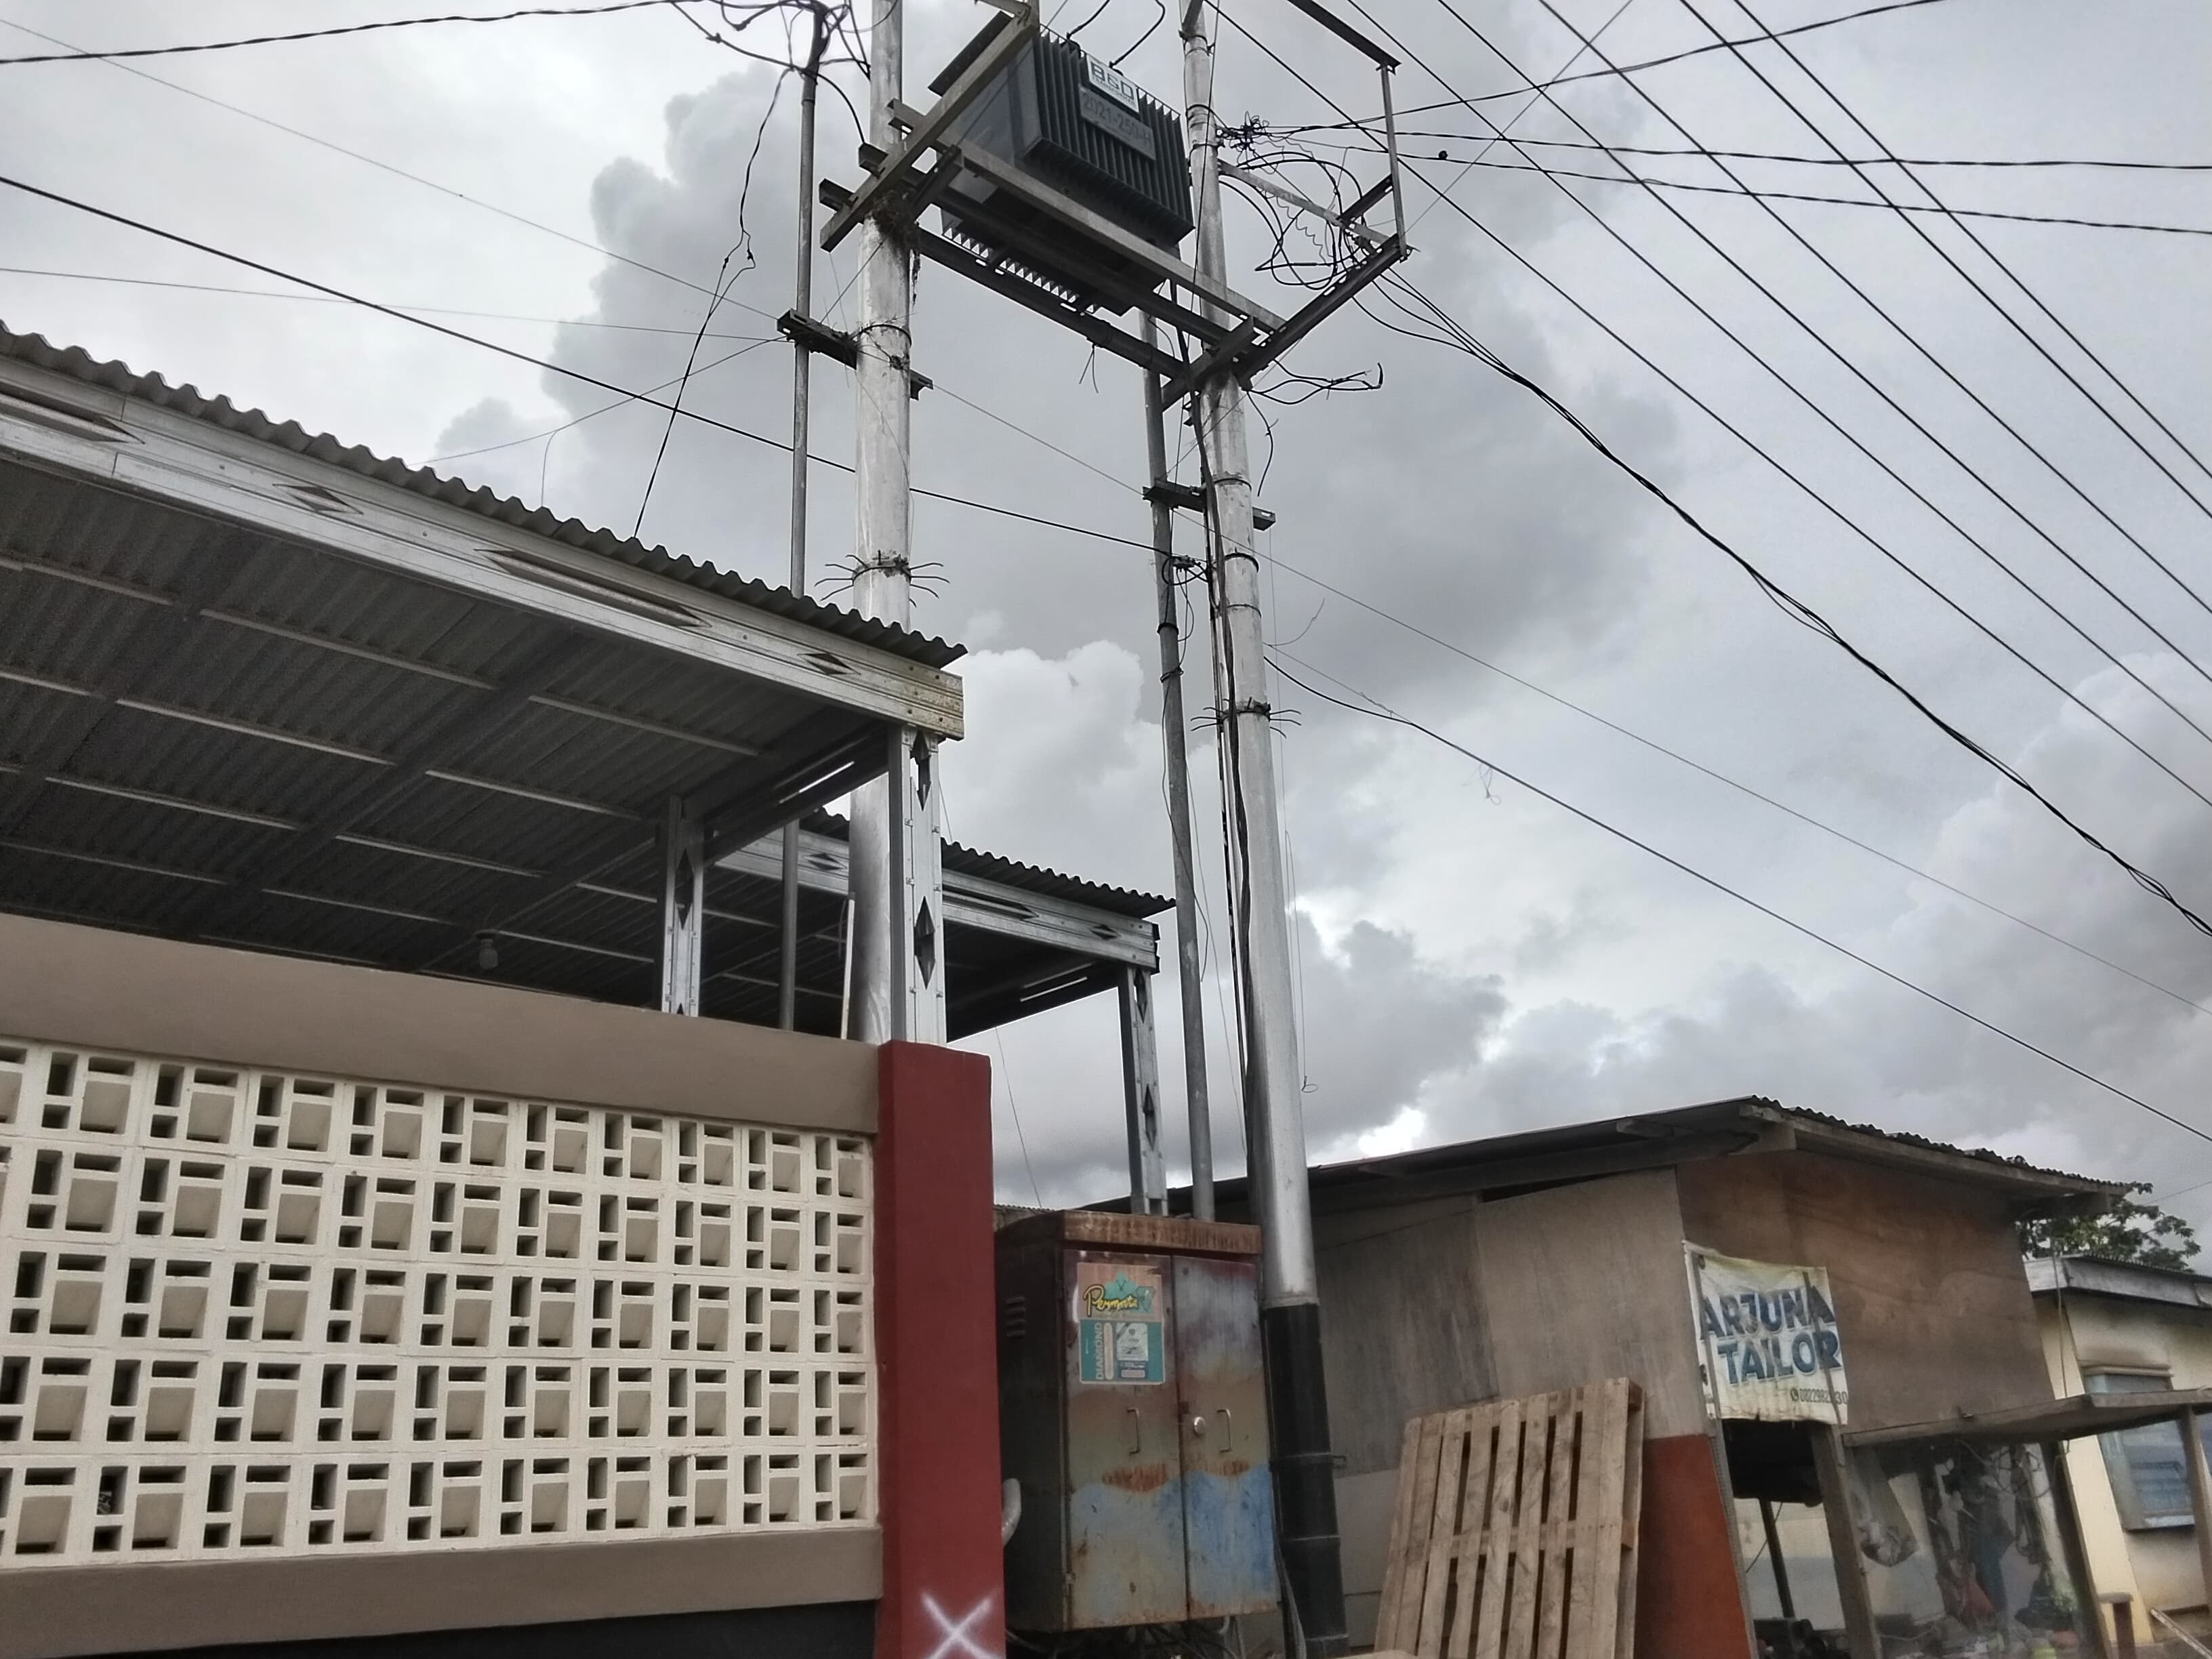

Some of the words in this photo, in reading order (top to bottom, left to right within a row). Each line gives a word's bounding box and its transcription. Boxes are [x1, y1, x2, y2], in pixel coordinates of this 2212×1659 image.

[1084, 1284, 1139, 1317] Permata
[1700, 1286, 1836, 1340] ARJUNA
[1094, 1322, 1105, 1380] DIAMOND
[1717, 1330, 1843, 1385] TAILOR
